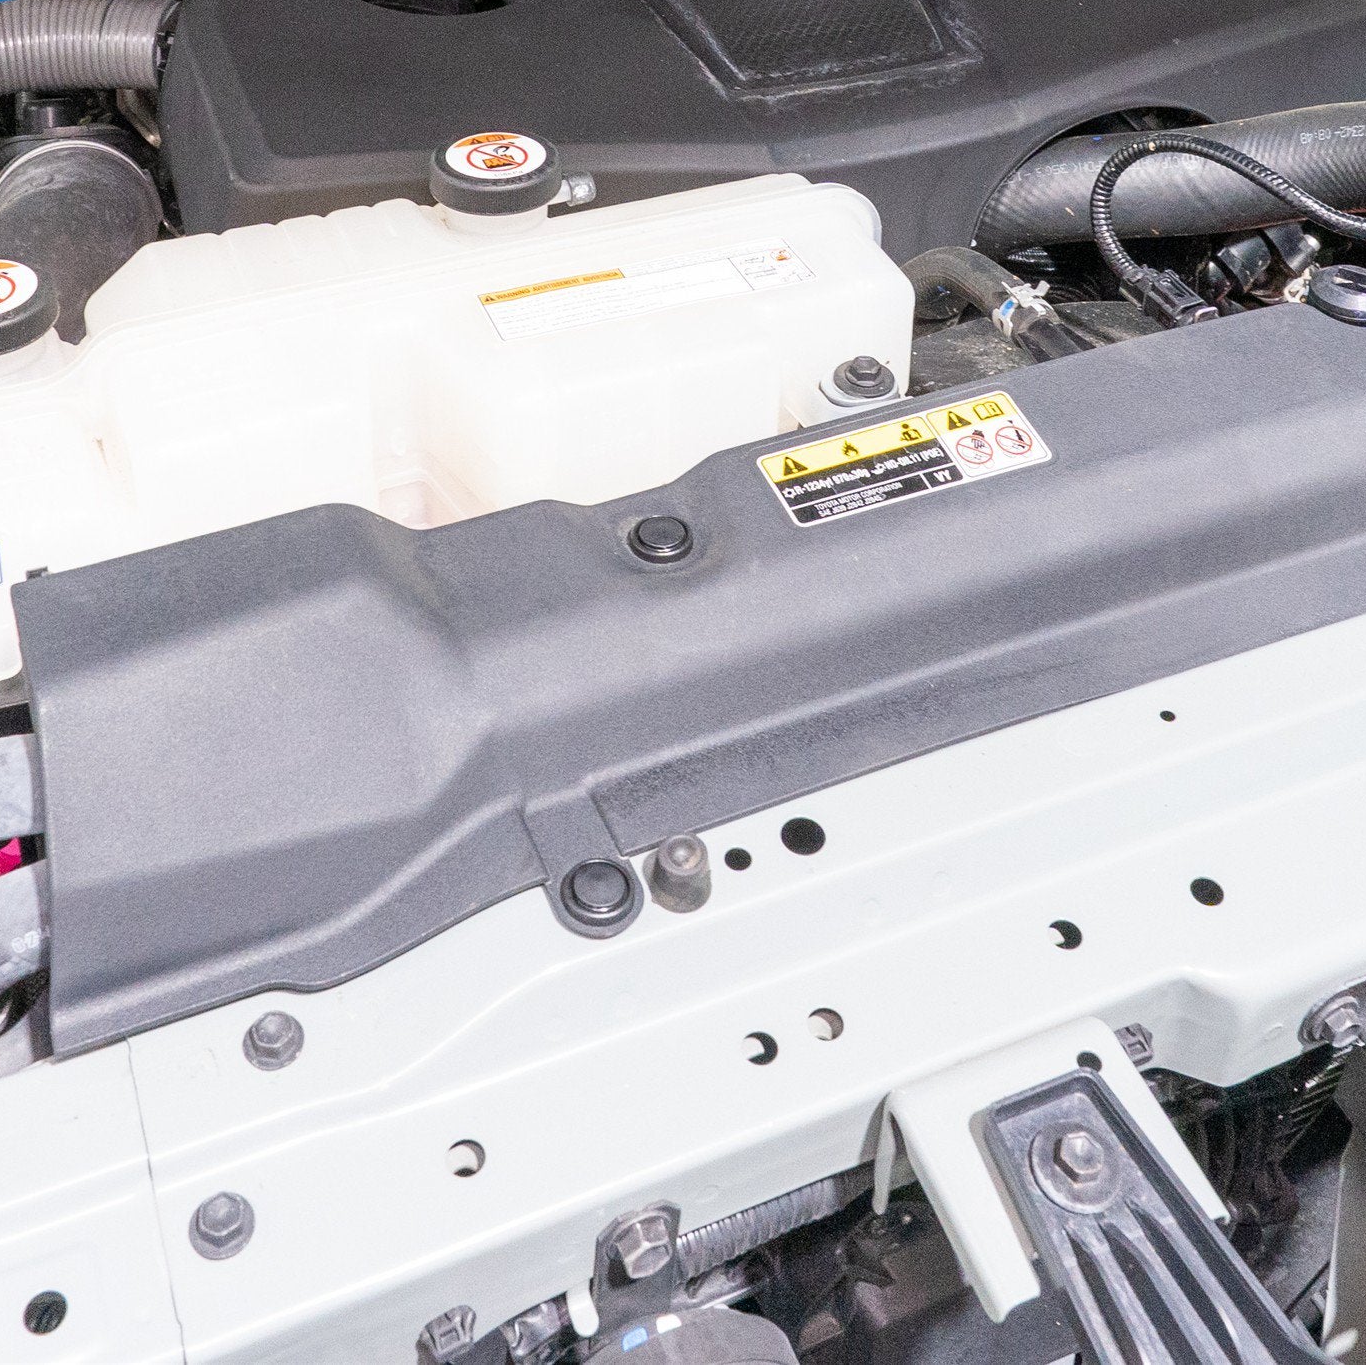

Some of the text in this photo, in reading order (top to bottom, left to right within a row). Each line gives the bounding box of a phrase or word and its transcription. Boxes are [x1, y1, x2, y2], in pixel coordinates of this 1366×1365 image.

[496, 288, 531, 300] WARNING
[933, 470, 952, 483] VY
[794, 479, 833, 495] R-1234yf
[814, 482, 903, 511] TOYOTA MOTOR CORPORATION
